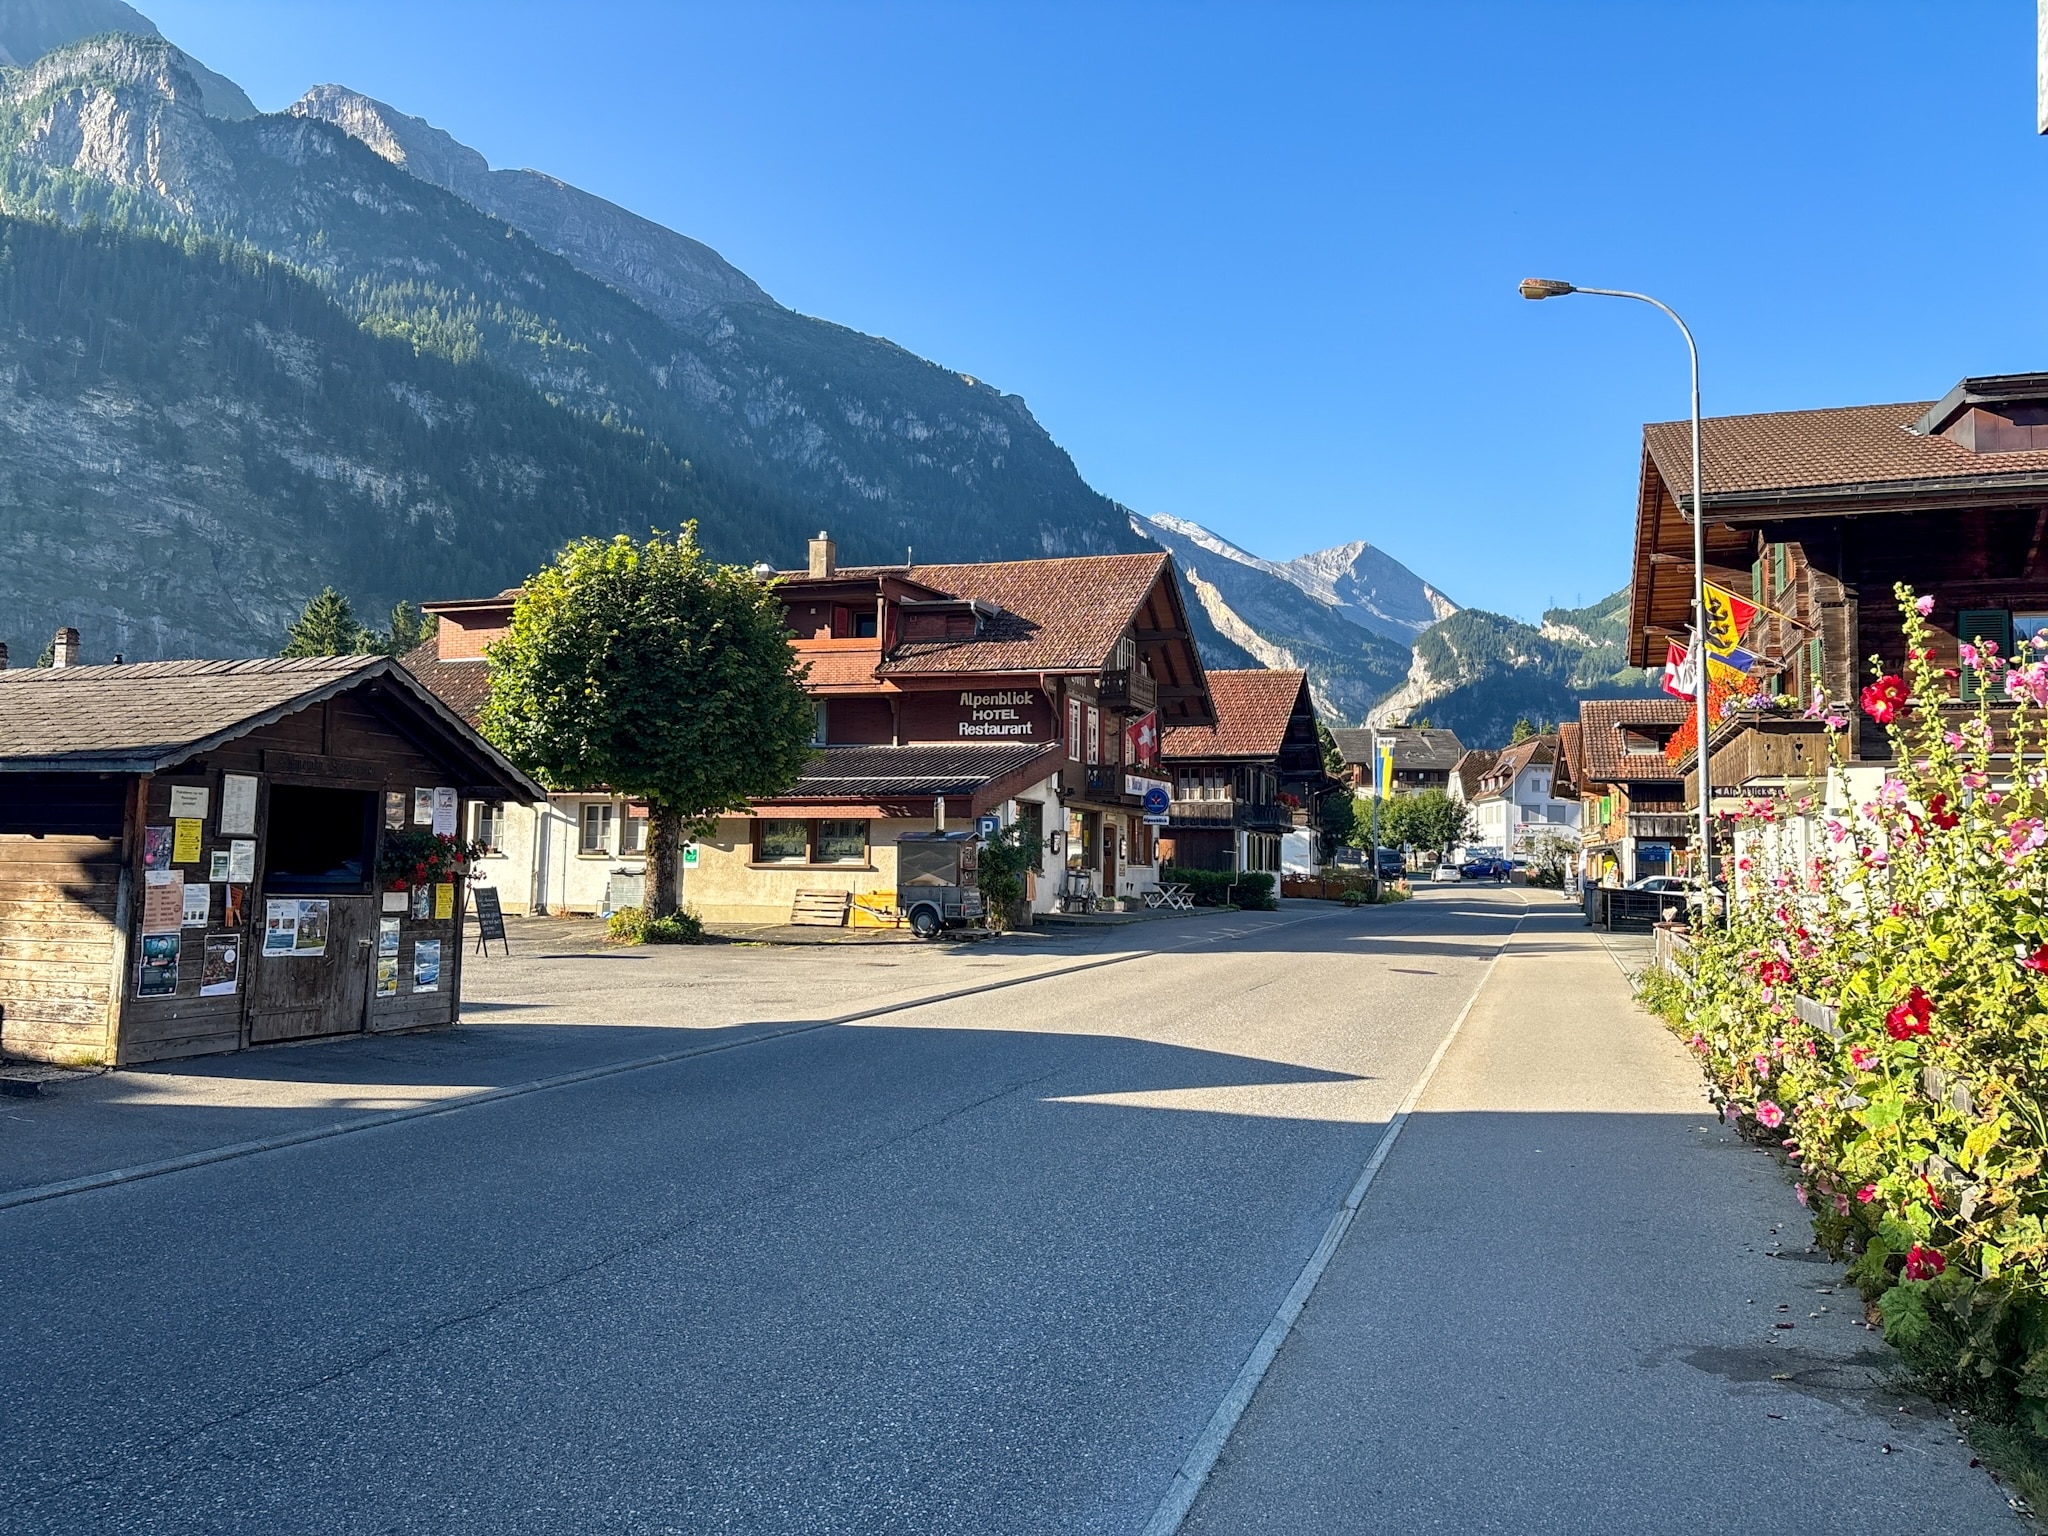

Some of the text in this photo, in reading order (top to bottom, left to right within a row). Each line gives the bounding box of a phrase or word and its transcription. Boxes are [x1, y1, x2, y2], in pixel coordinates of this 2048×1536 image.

[960, 691, 1034, 709] Alpenblick
[973, 709, 1019, 721] HOTEL
[959, 721, 1033, 736] Restaurant
[981, 821, 993, 838] P
